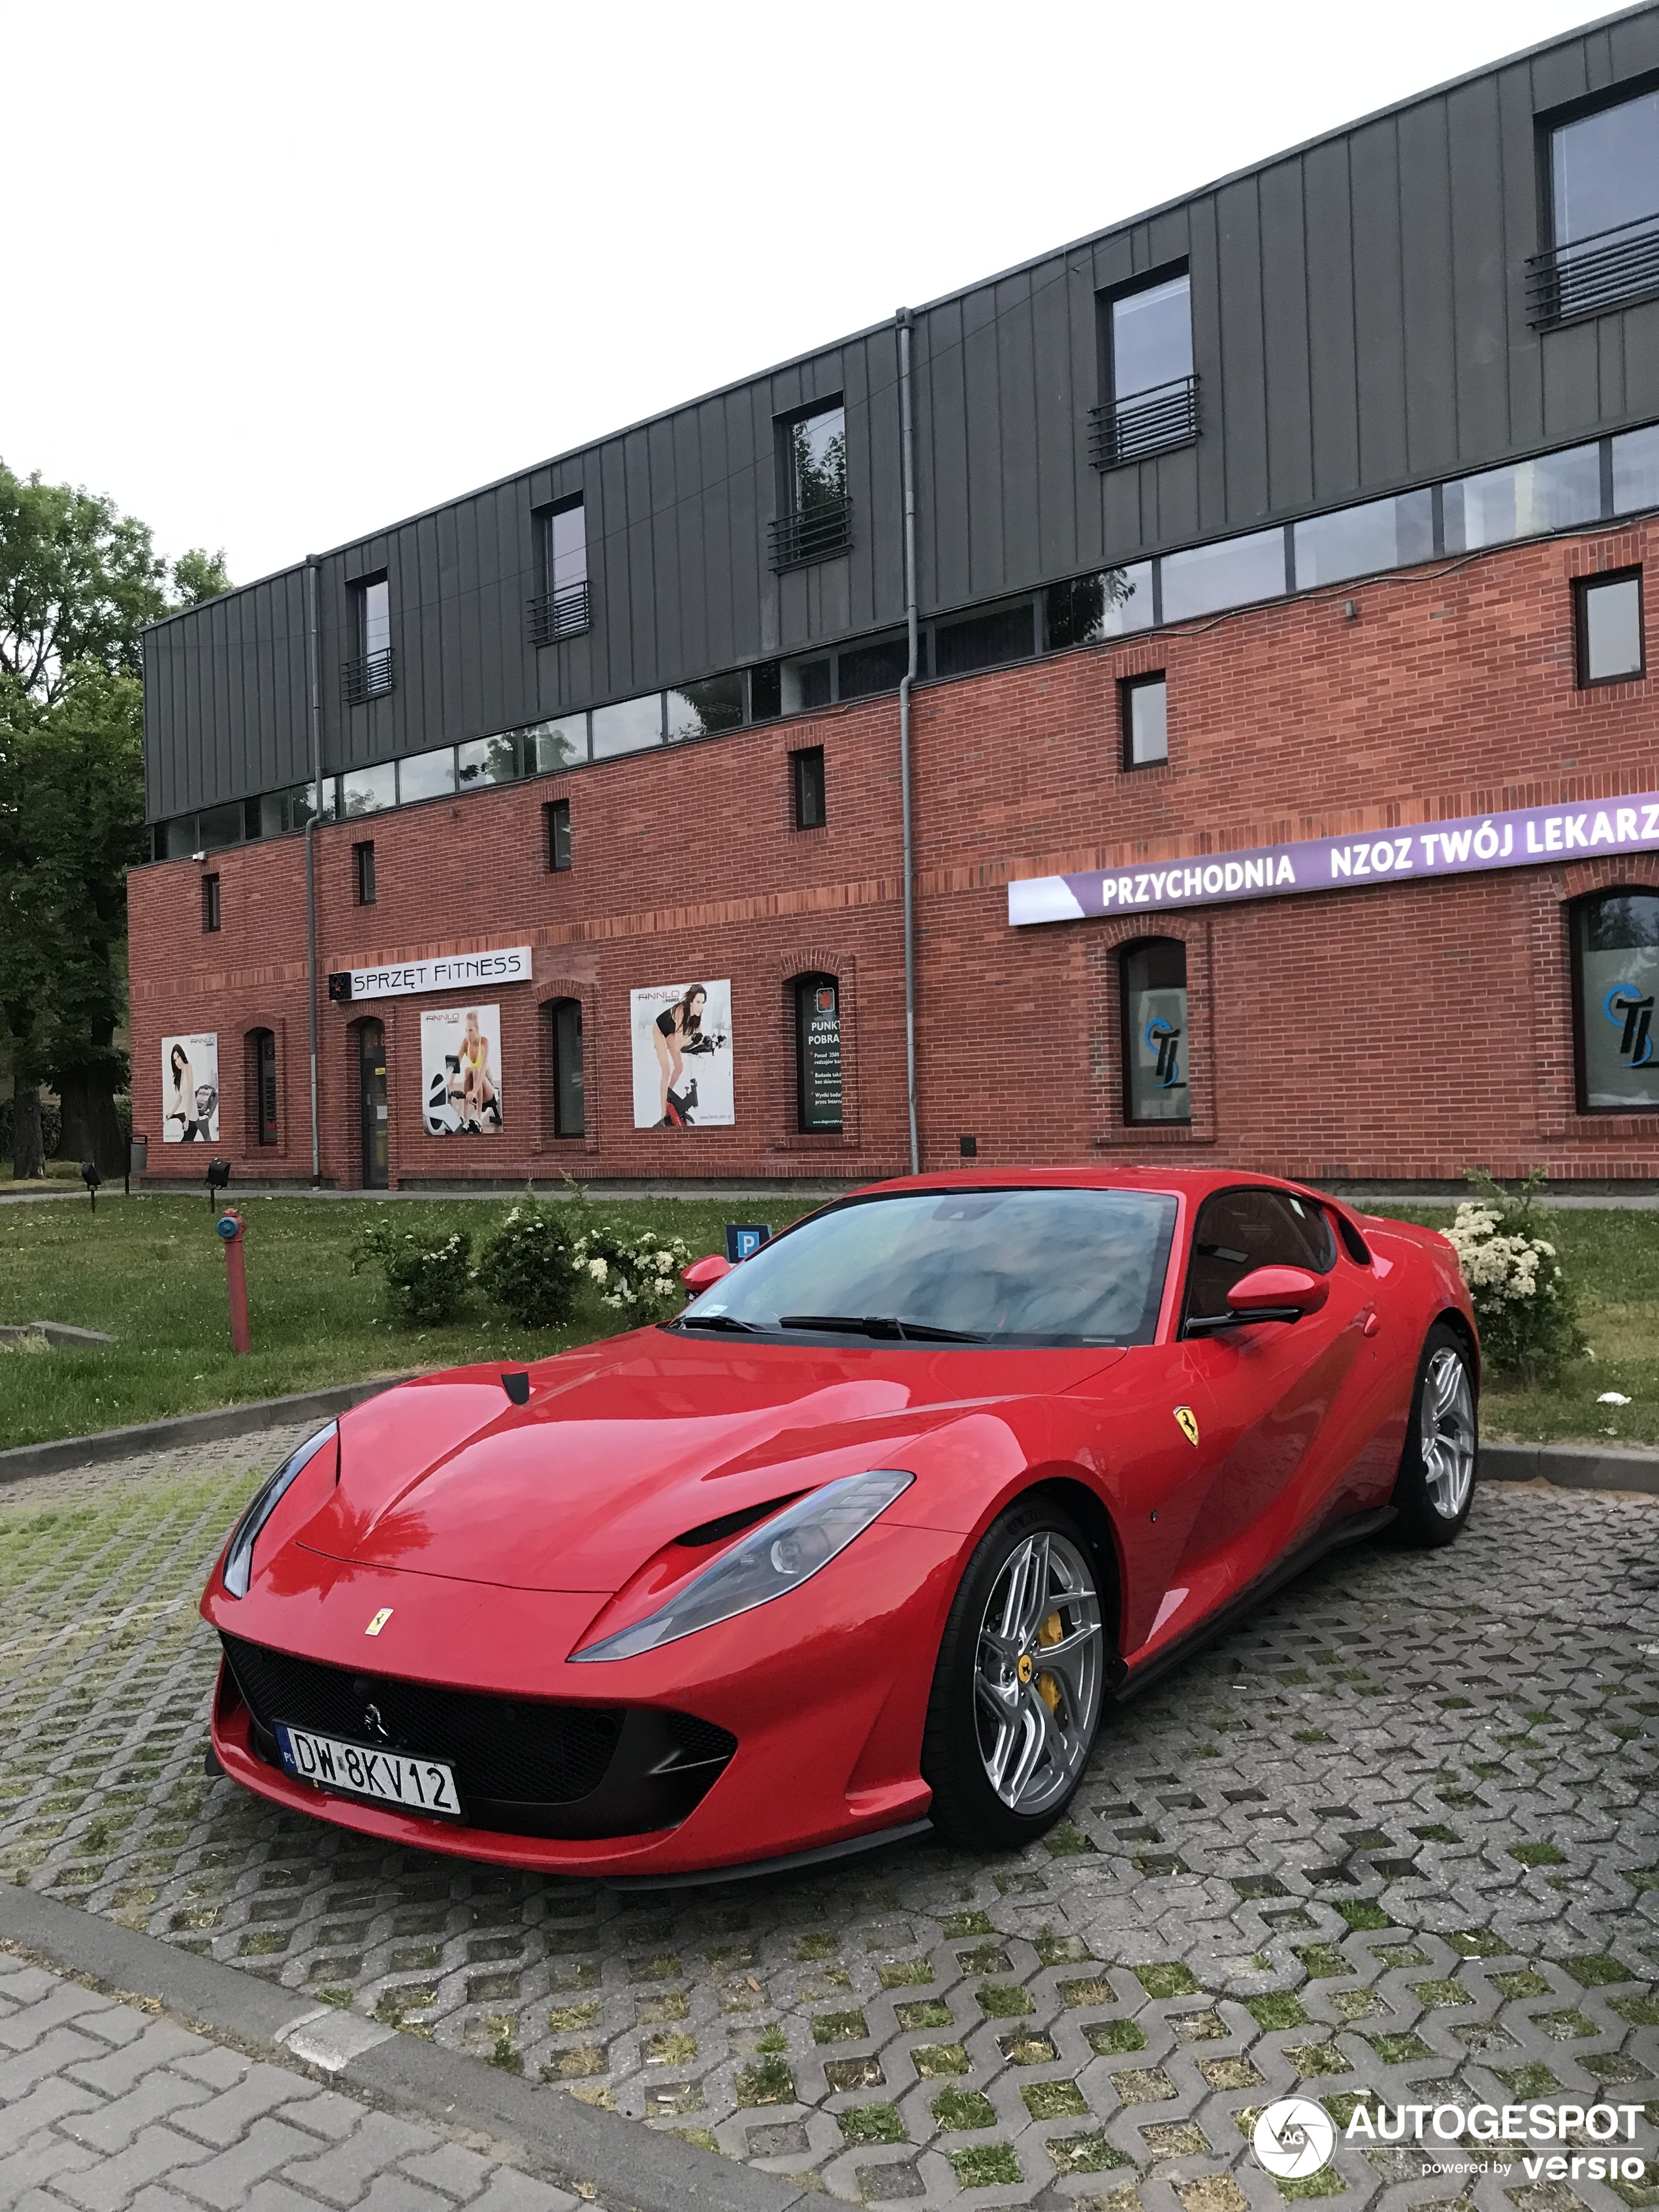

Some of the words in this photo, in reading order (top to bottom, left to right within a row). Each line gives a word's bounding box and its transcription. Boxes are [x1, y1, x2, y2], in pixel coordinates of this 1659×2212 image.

[1103, 856, 1295, 906] PRZYCHODNIA
[1331, 838, 1412, 878] NZOZ
[1421, 820, 1513, 865] TWÓJ
[1526, 804, 1659, 854] LEKARZ
[354, 968, 427, 991] SPRZĘT
[435, 955, 521, 981] FITNESS
[637, 990, 680, 1001] FINNLO
[808, 1034, 840, 1045] POBRA
[743, 1236, 755, 1254] P
[294, 1733, 336, 1781] DW
[345, 1748, 452, 1809] 8KV12
